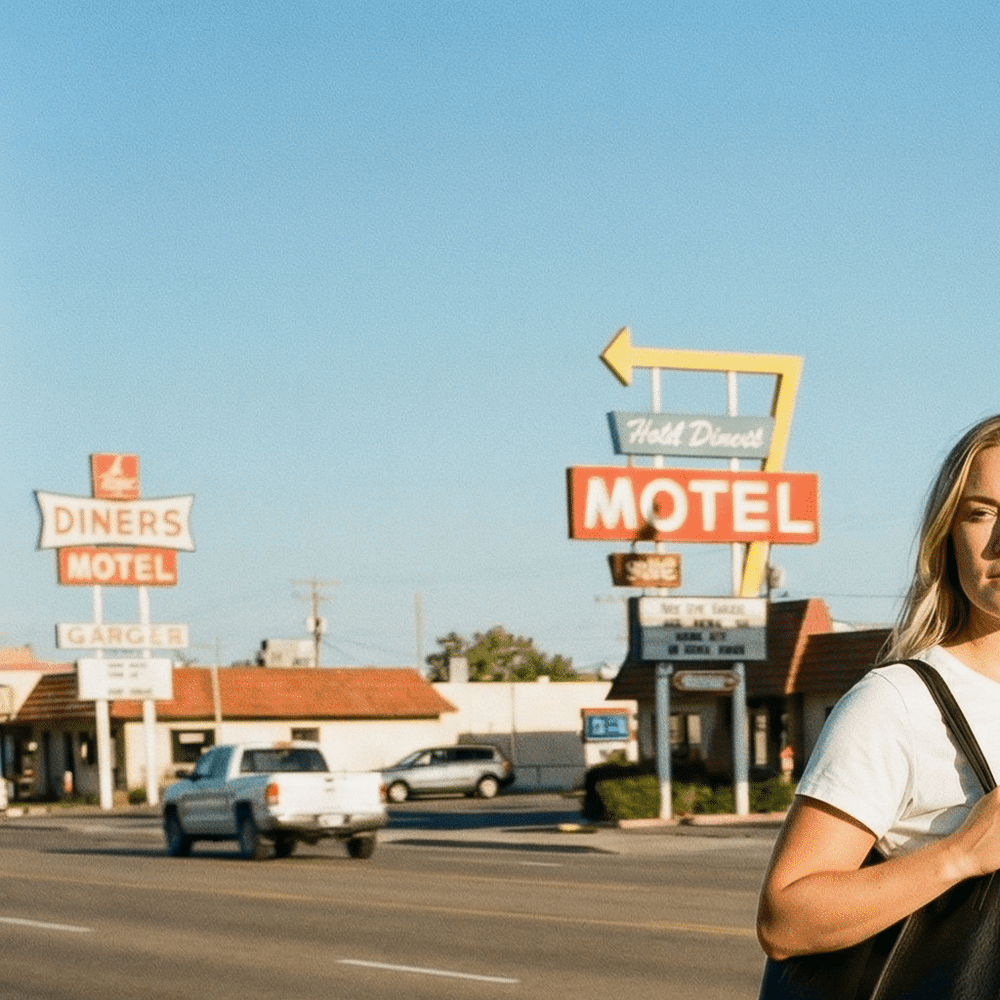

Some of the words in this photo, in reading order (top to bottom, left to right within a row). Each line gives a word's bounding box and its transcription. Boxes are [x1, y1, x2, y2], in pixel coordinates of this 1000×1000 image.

[583, 474, 815, 534] MOTEL
[54, 505, 182, 537] DINERS
[67, 551, 174, 582] MOTEL
